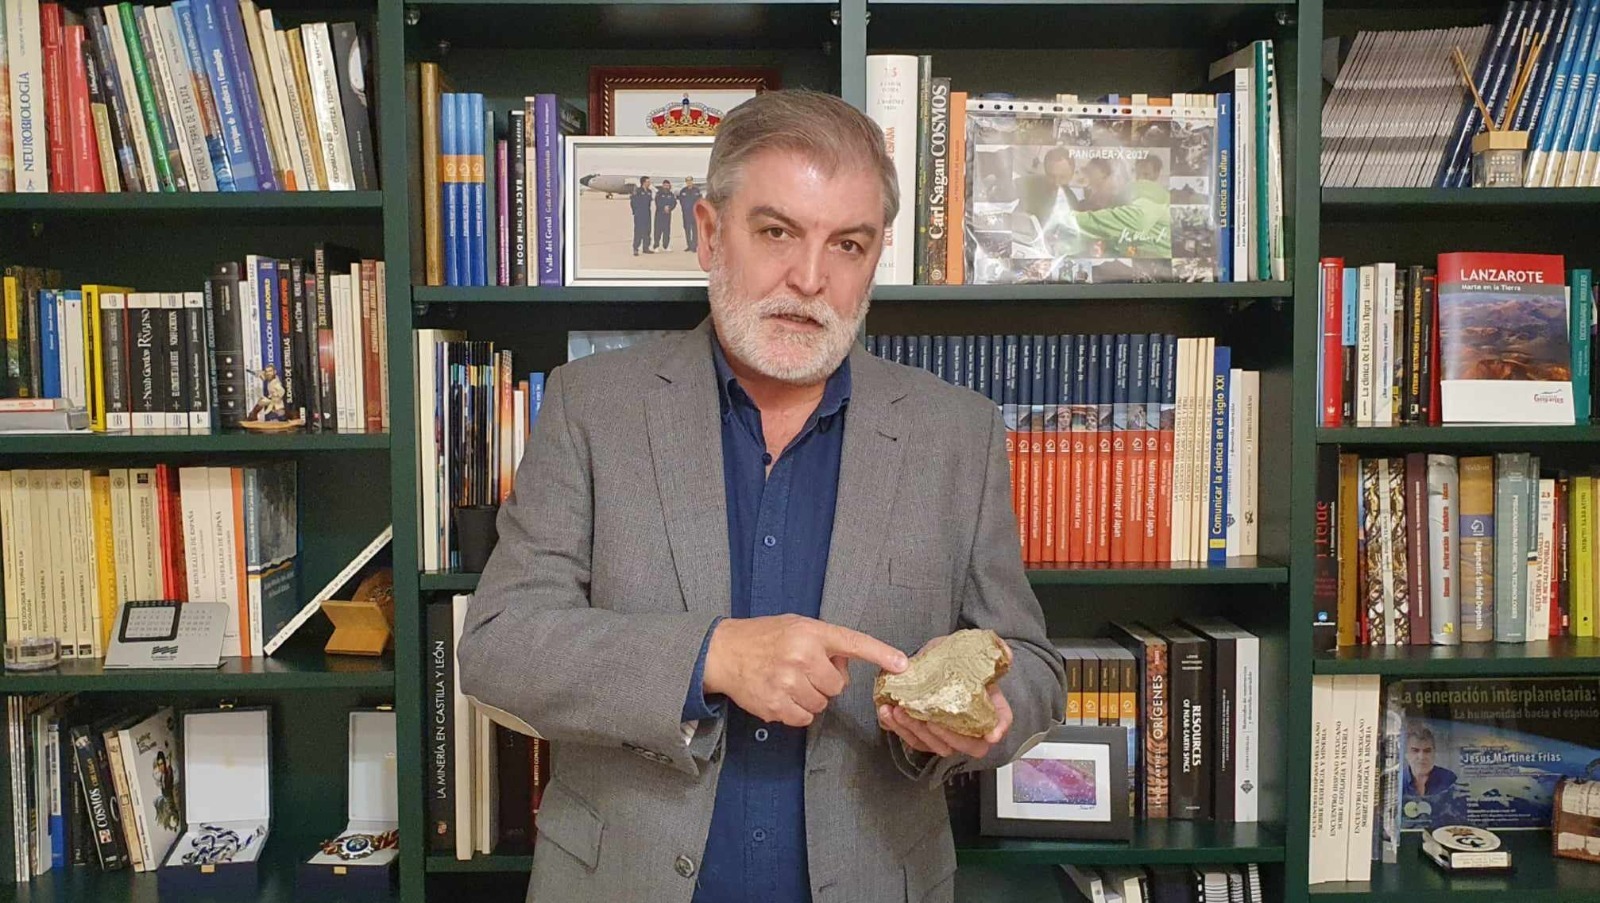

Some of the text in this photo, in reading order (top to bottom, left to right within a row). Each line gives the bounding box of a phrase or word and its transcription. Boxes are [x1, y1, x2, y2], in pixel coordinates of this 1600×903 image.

[180, 85, 190, 103] PLATA
[19, 72, 34, 171] NEUROBIOLOGÍA
[929, 85, 948, 239] Carl Sagan COSMOS
[1126, 149, 1149, 160] 2017
[1219, 149, 1228, 177] Cultura
[1220, 178, 1227, 187] es
[517, 207, 523, 216] TO
[1219, 189, 1227, 217] Ciencia
[544, 217, 553, 239] Genal
[1220, 219, 1227, 227] La
[544, 240, 553, 252] del
[545, 254, 553, 273] Valle
[1461, 269, 1544, 283] LANZAROTE
[282, 306, 290, 333] GREGORY
[266, 322, 274, 362] DESOLACIÓN
[283, 338, 291, 367] ESTRELLAS
[141, 349, 152, 376] Gordon
[142, 378, 152, 400] Noah
[284, 378, 293, 403] SUDARIO
[1362, 387, 1369, 397] La
[1213, 375, 1227, 534] Comunicar la ciencia en el siglo XXI
[1148, 459, 1156, 483] Natural
[1114, 484, 1123, 510] Heritage
[1146, 484, 1155, 510] Heritage
[1114, 520, 1122, 537] Japan
[1146, 520, 1154, 537] Japan
[1474, 541, 1483, 575] Magmatic
[1475, 601, 1483, 630] Deposits
[432, 640, 445, 668] LEÓN
[435, 680, 445, 724] CASTILLA
[1149, 674, 1164, 739] ORÍGENES
[1183, 699, 1190, 710] OF
[1416, 686, 1488, 707] generación
[1492, 685, 1596, 706] interplanetaria:
[1454, 709, 1464, 719] La
[1467, 708, 1522, 719] humanidad
[1525, 708, 1550, 718] hacia
[1552, 708, 1561, 718] el
[436, 726, 445, 740] EN
[1192, 705, 1202, 766] RESOURCES
[434, 743, 446, 785] MINERÍA
[437, 787, 446, 798] LA
[89, 788, 108, 828] COSMOS
